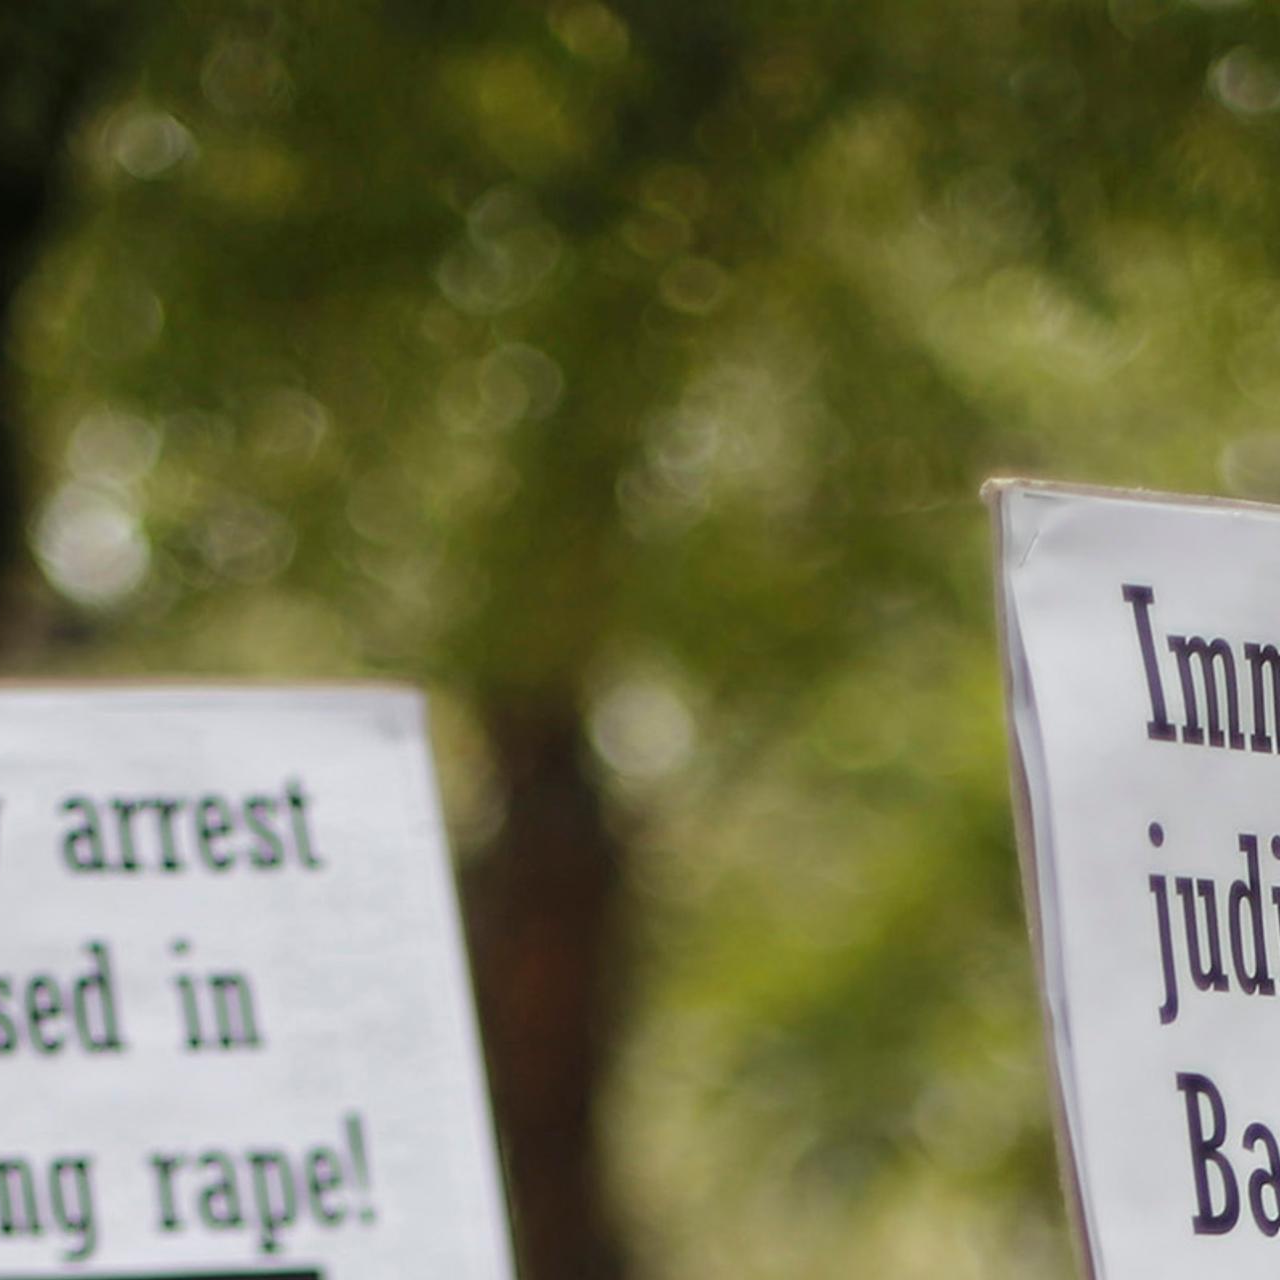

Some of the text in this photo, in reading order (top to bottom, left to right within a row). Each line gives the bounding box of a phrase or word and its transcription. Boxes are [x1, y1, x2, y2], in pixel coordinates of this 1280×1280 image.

[58, 777, 326, 876] arrest
[170, 941, 265, 1053] in
[152, 1112, 379, 1255] rape!
